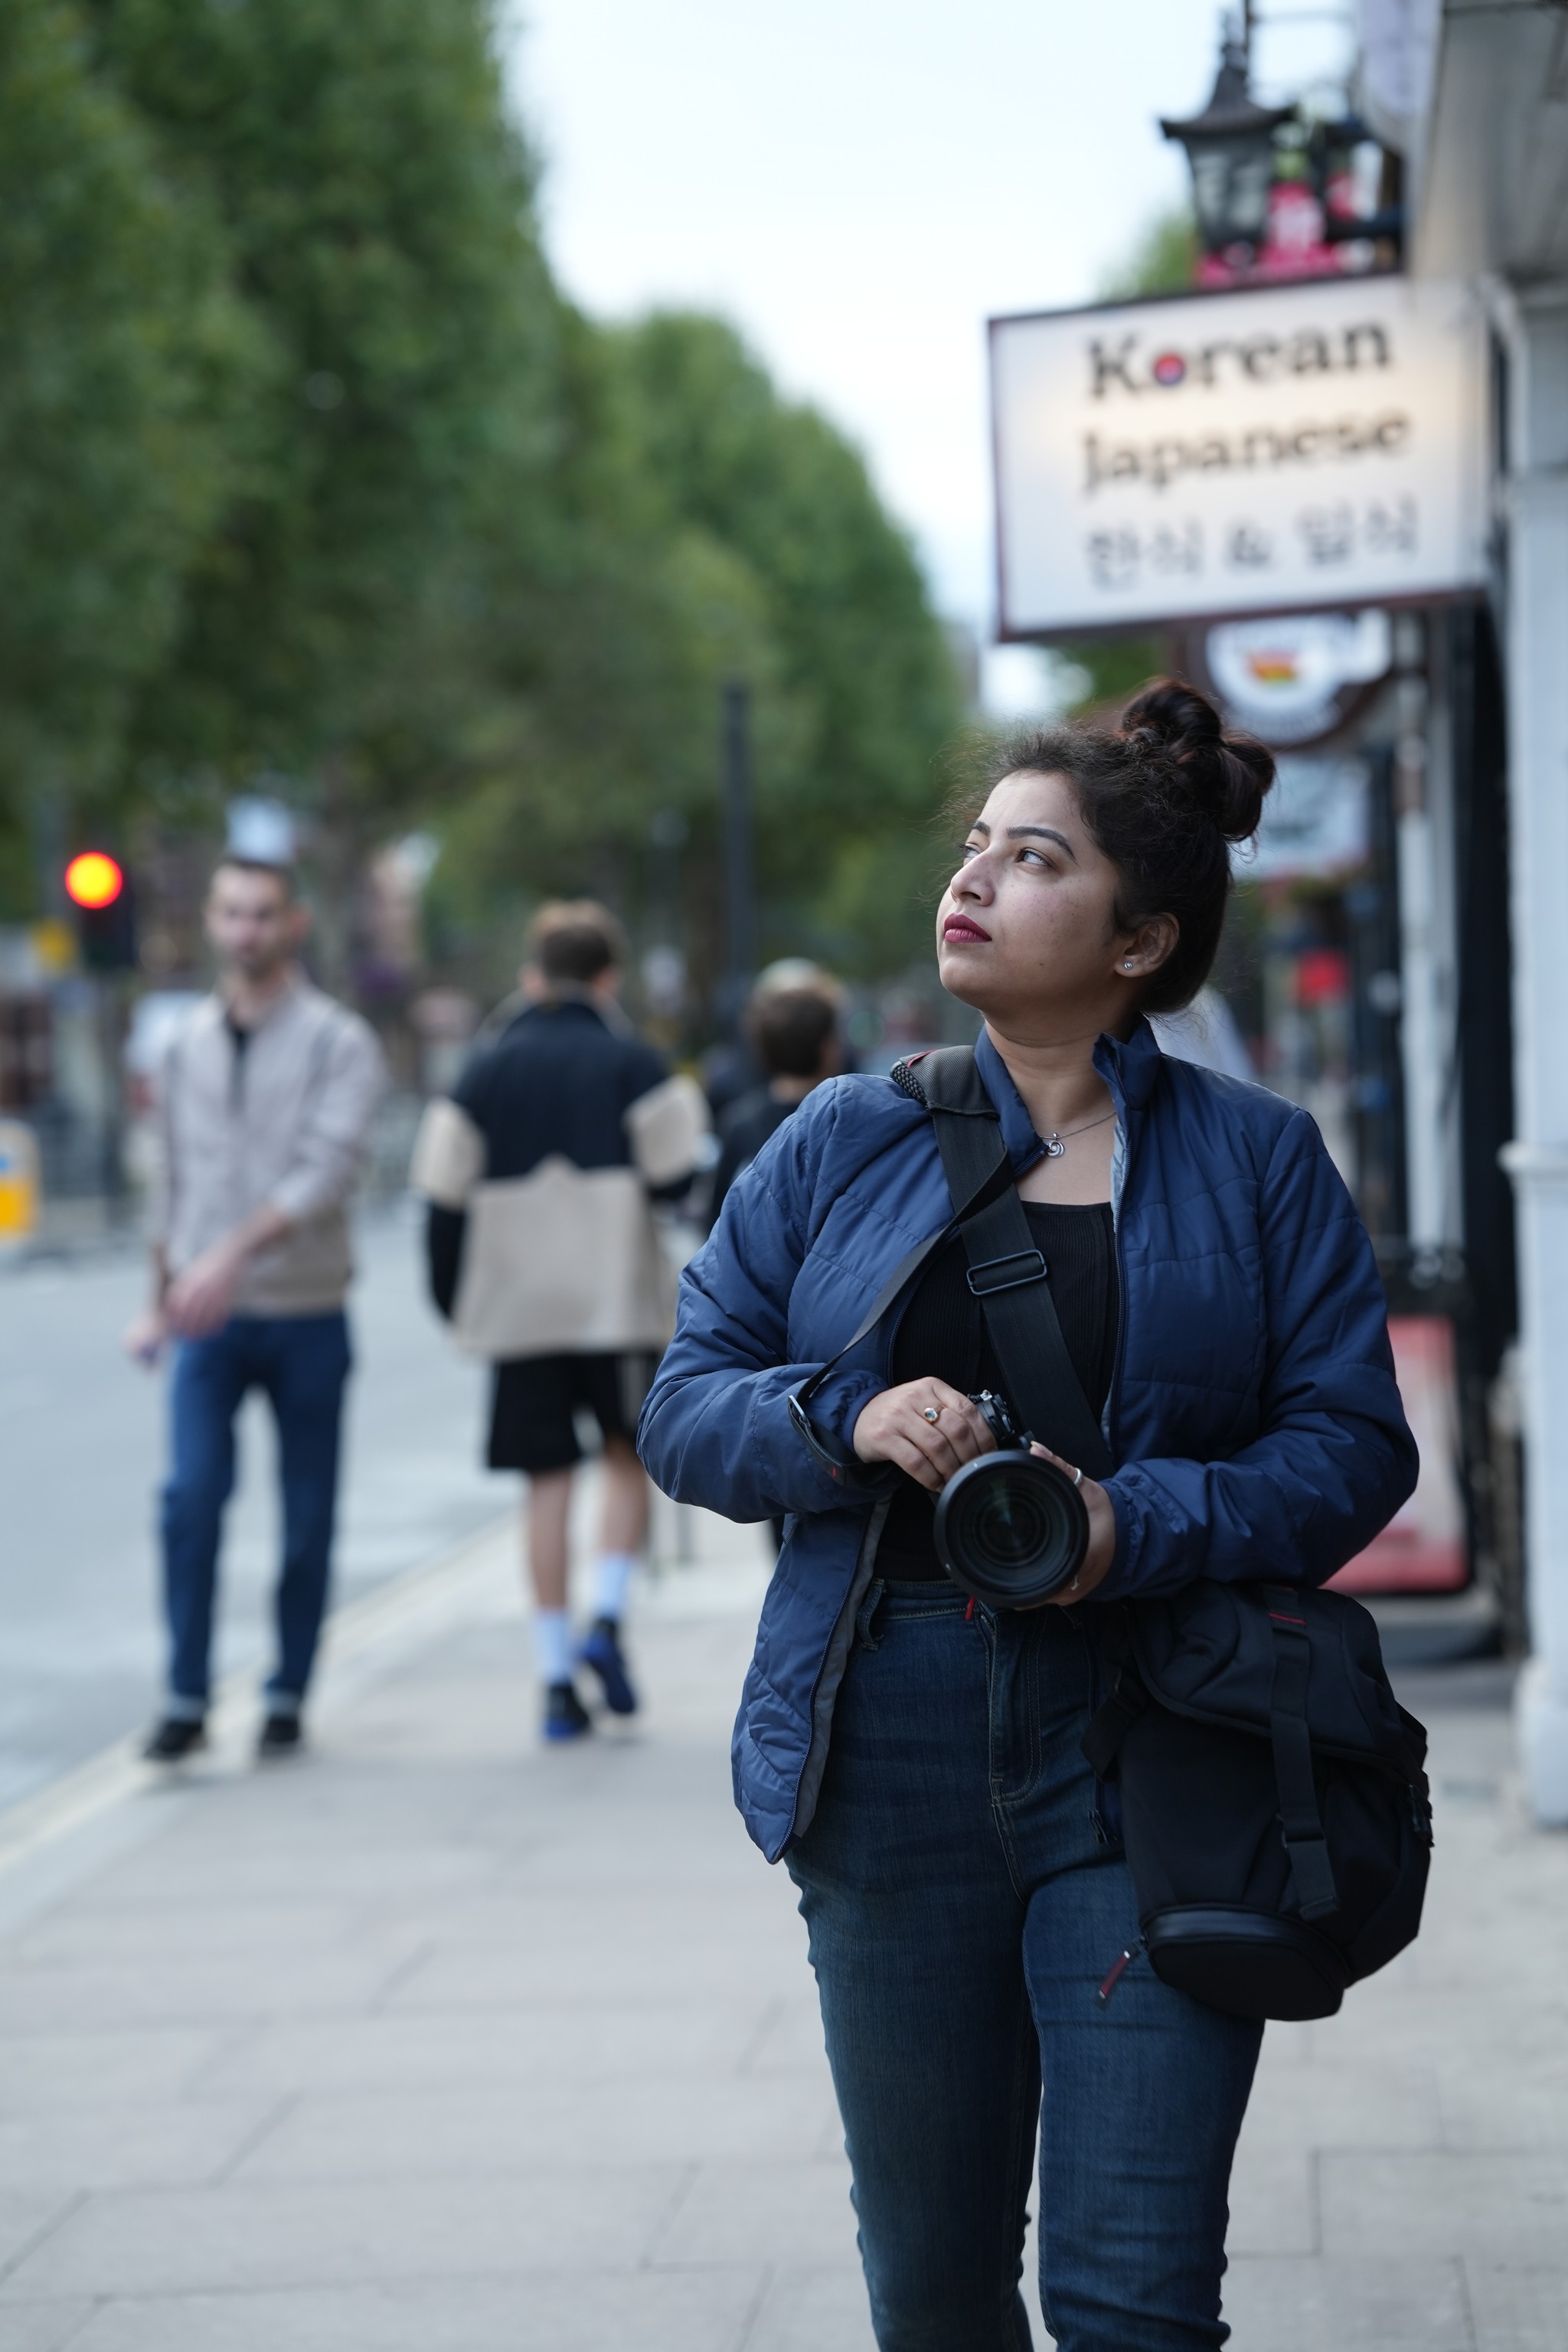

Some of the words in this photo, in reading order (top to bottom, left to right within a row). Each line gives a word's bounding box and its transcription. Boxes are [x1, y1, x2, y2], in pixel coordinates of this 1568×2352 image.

[1089, 318, 1393, 399] Korean
[1085, 409, 1410, 495] Japanese
[1227, 514, 1274, 571] &
